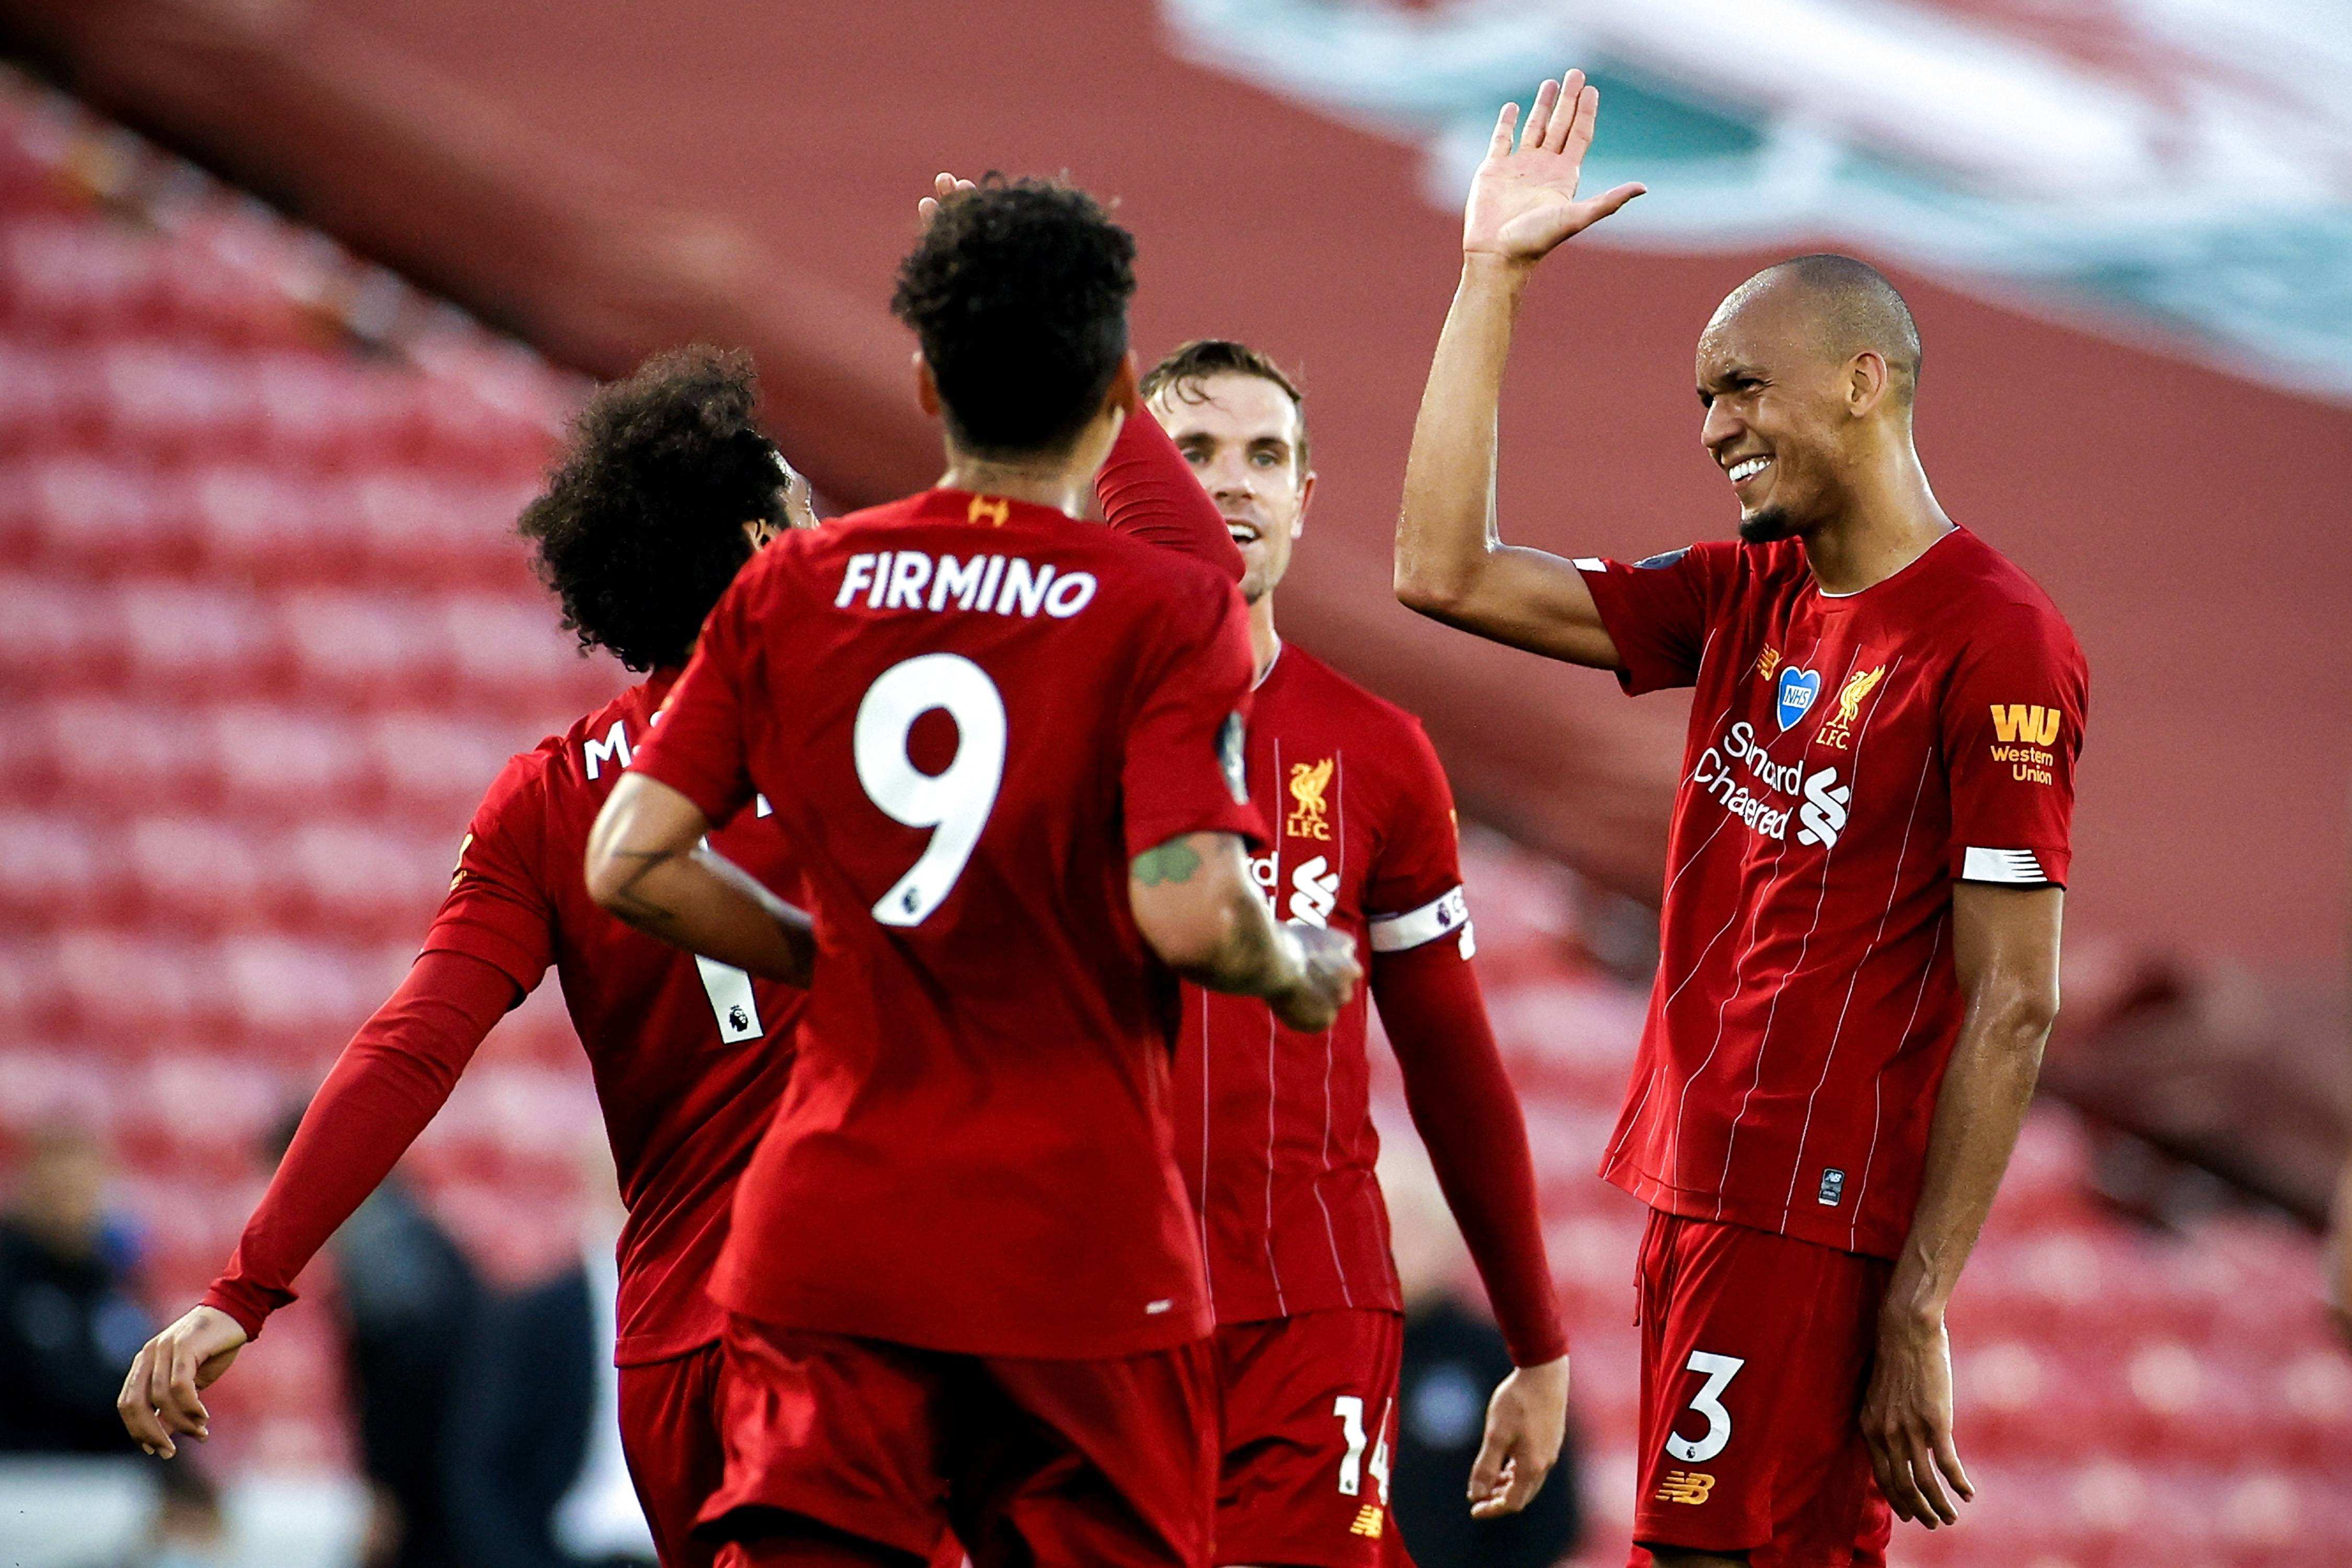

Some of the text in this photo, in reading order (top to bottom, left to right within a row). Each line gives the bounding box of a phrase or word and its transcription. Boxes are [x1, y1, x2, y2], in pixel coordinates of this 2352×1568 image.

[835, 550, 1097, 618] FIRMINO
[1784, 688, 1809, 706] NHS
[1990, 704, 2061, 747] WU
[1990, 745, 2054, 767] Western
[2013, 764, 2052, 786] Union
[854, 652, 1008, 927] 9
[1694, 747, 1794, 840] Chaered
[1666, 1350, 1745, 1462] 3
